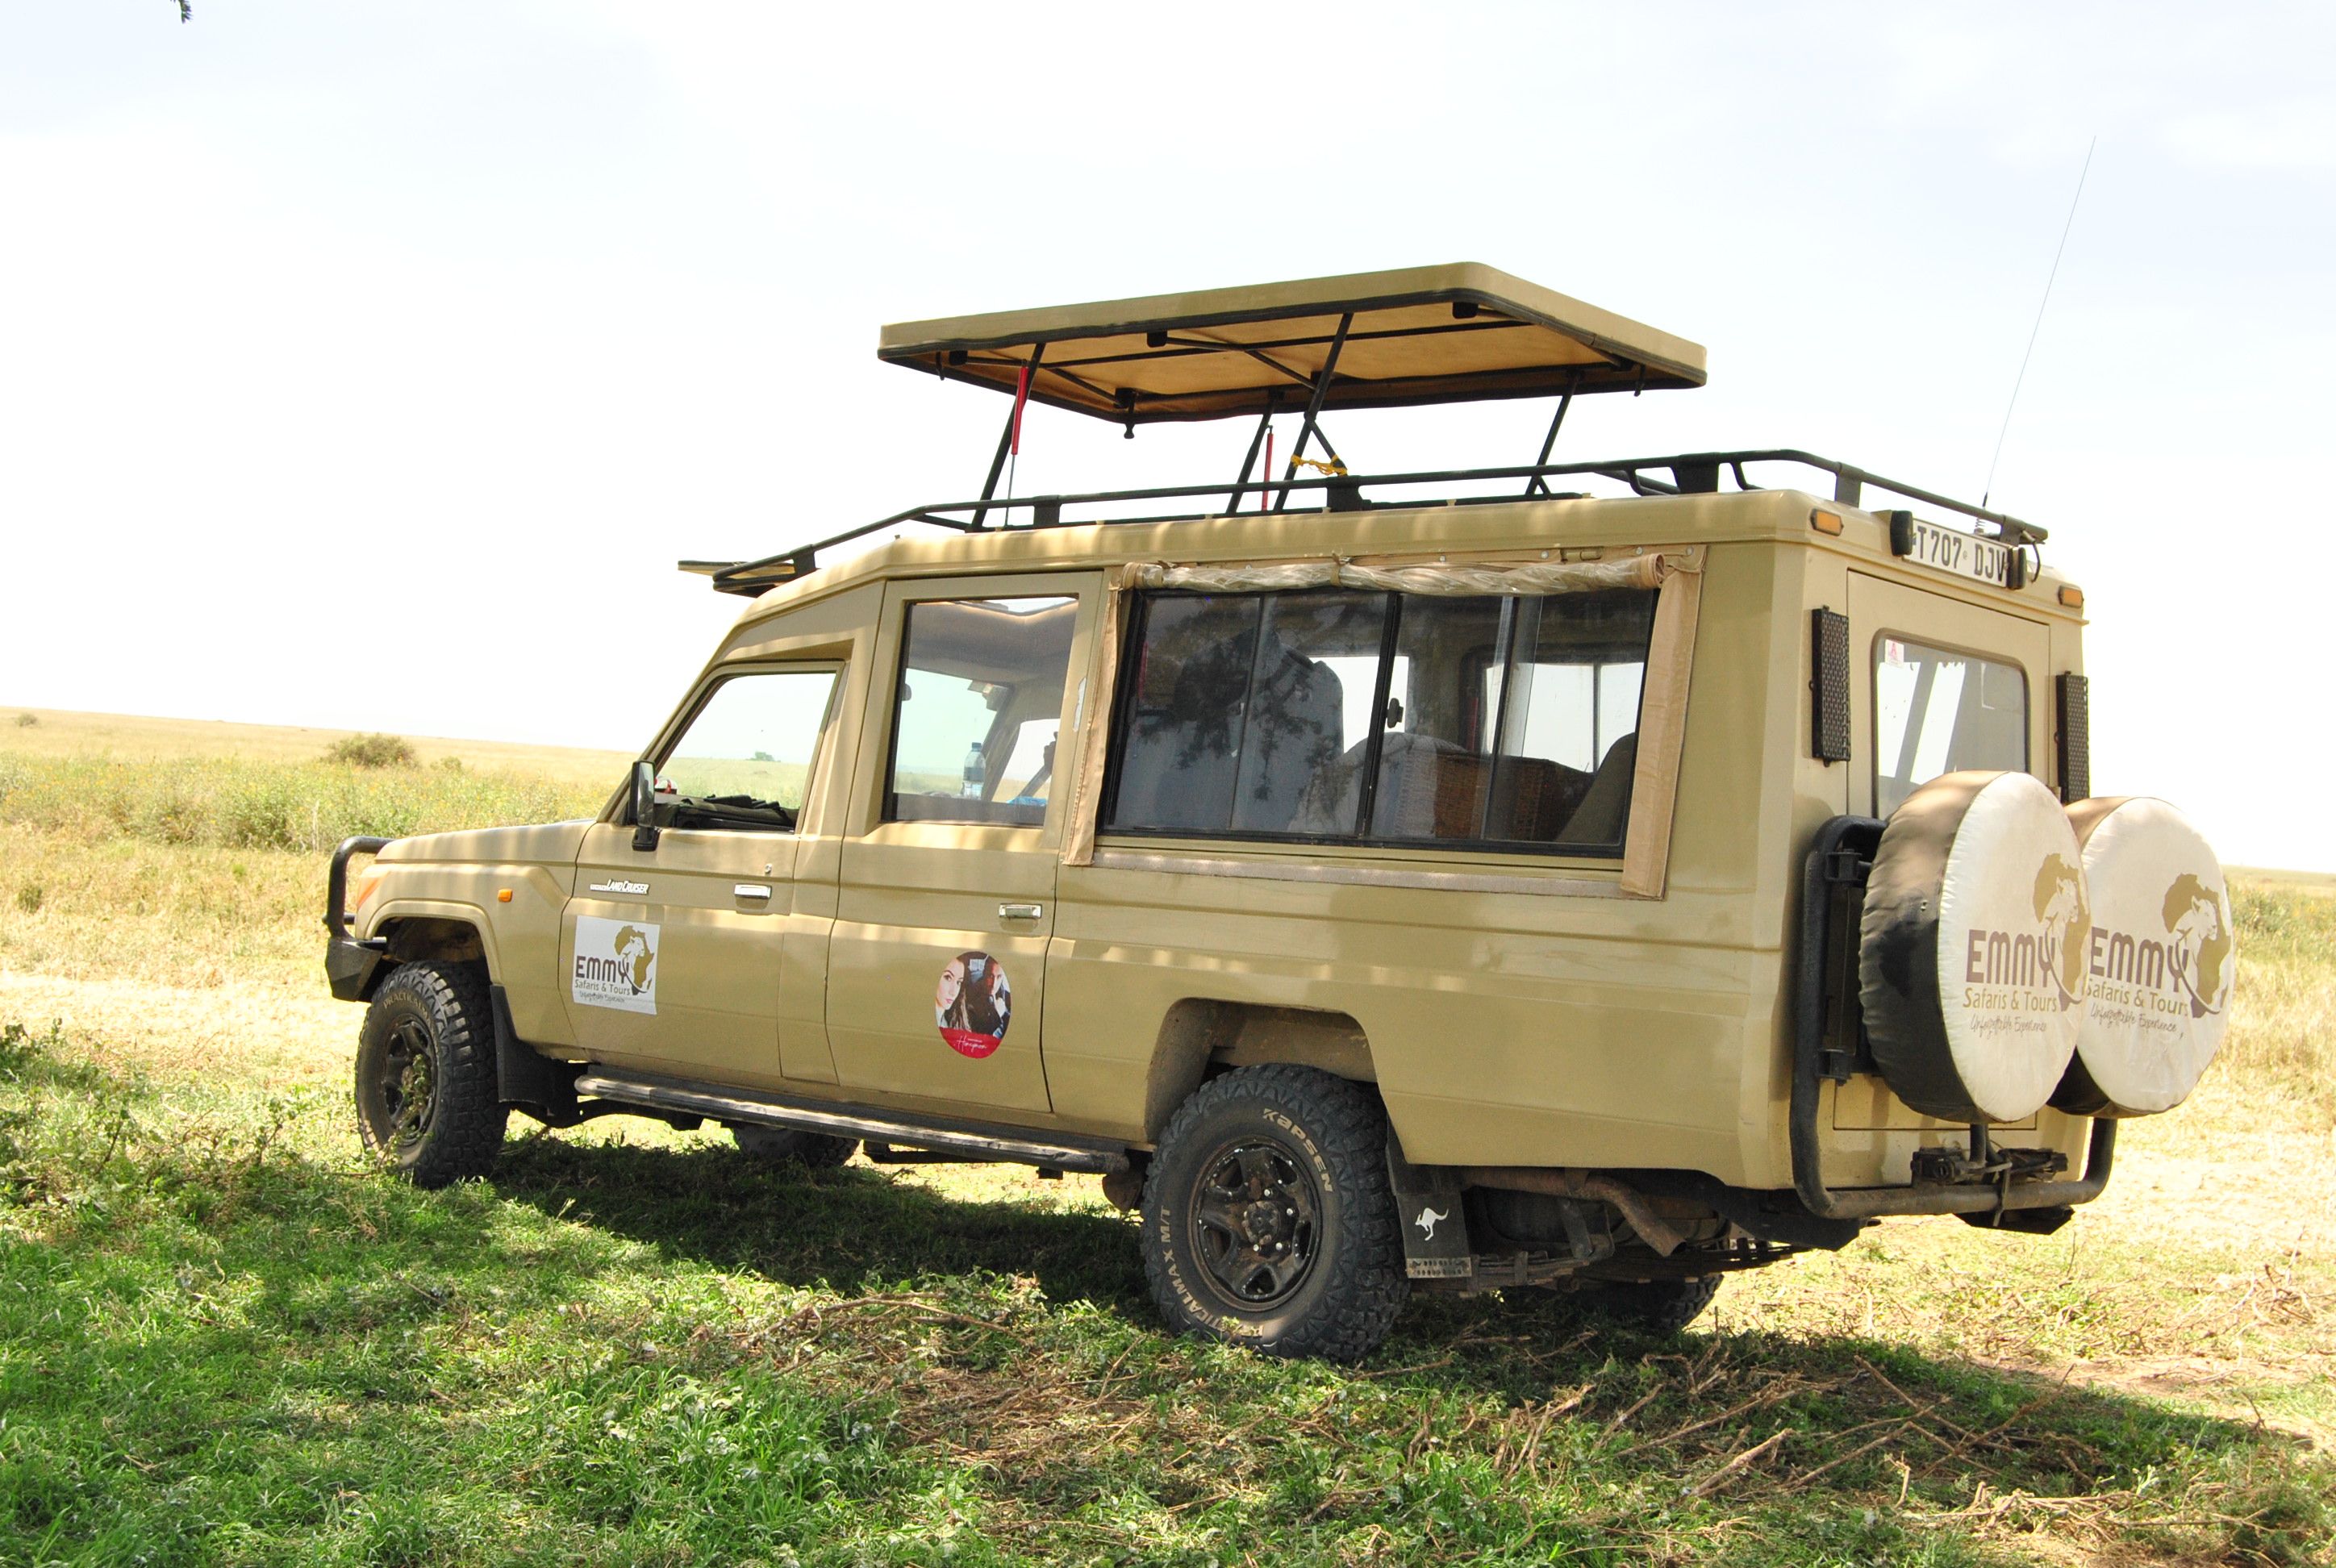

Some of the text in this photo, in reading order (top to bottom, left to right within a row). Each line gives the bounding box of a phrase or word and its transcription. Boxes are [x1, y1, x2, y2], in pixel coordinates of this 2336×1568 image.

[1974, 543, 2005, 582] DJV
[575, 956, 629, 983] EMMY
[1966, 929, 2055, 987] EMMY
[2089, 927, 2189, 992] EMMY
[574, 979, 631, 996] Safaris & Tours
[1963, 987, 2057, 1012] Safaris & Tours
[2134, 989, 2144, 1008] &
[2150, 991, 2188, 1016] Tours
[1162, 1249, 1264, 1337] PRTICALMAX
